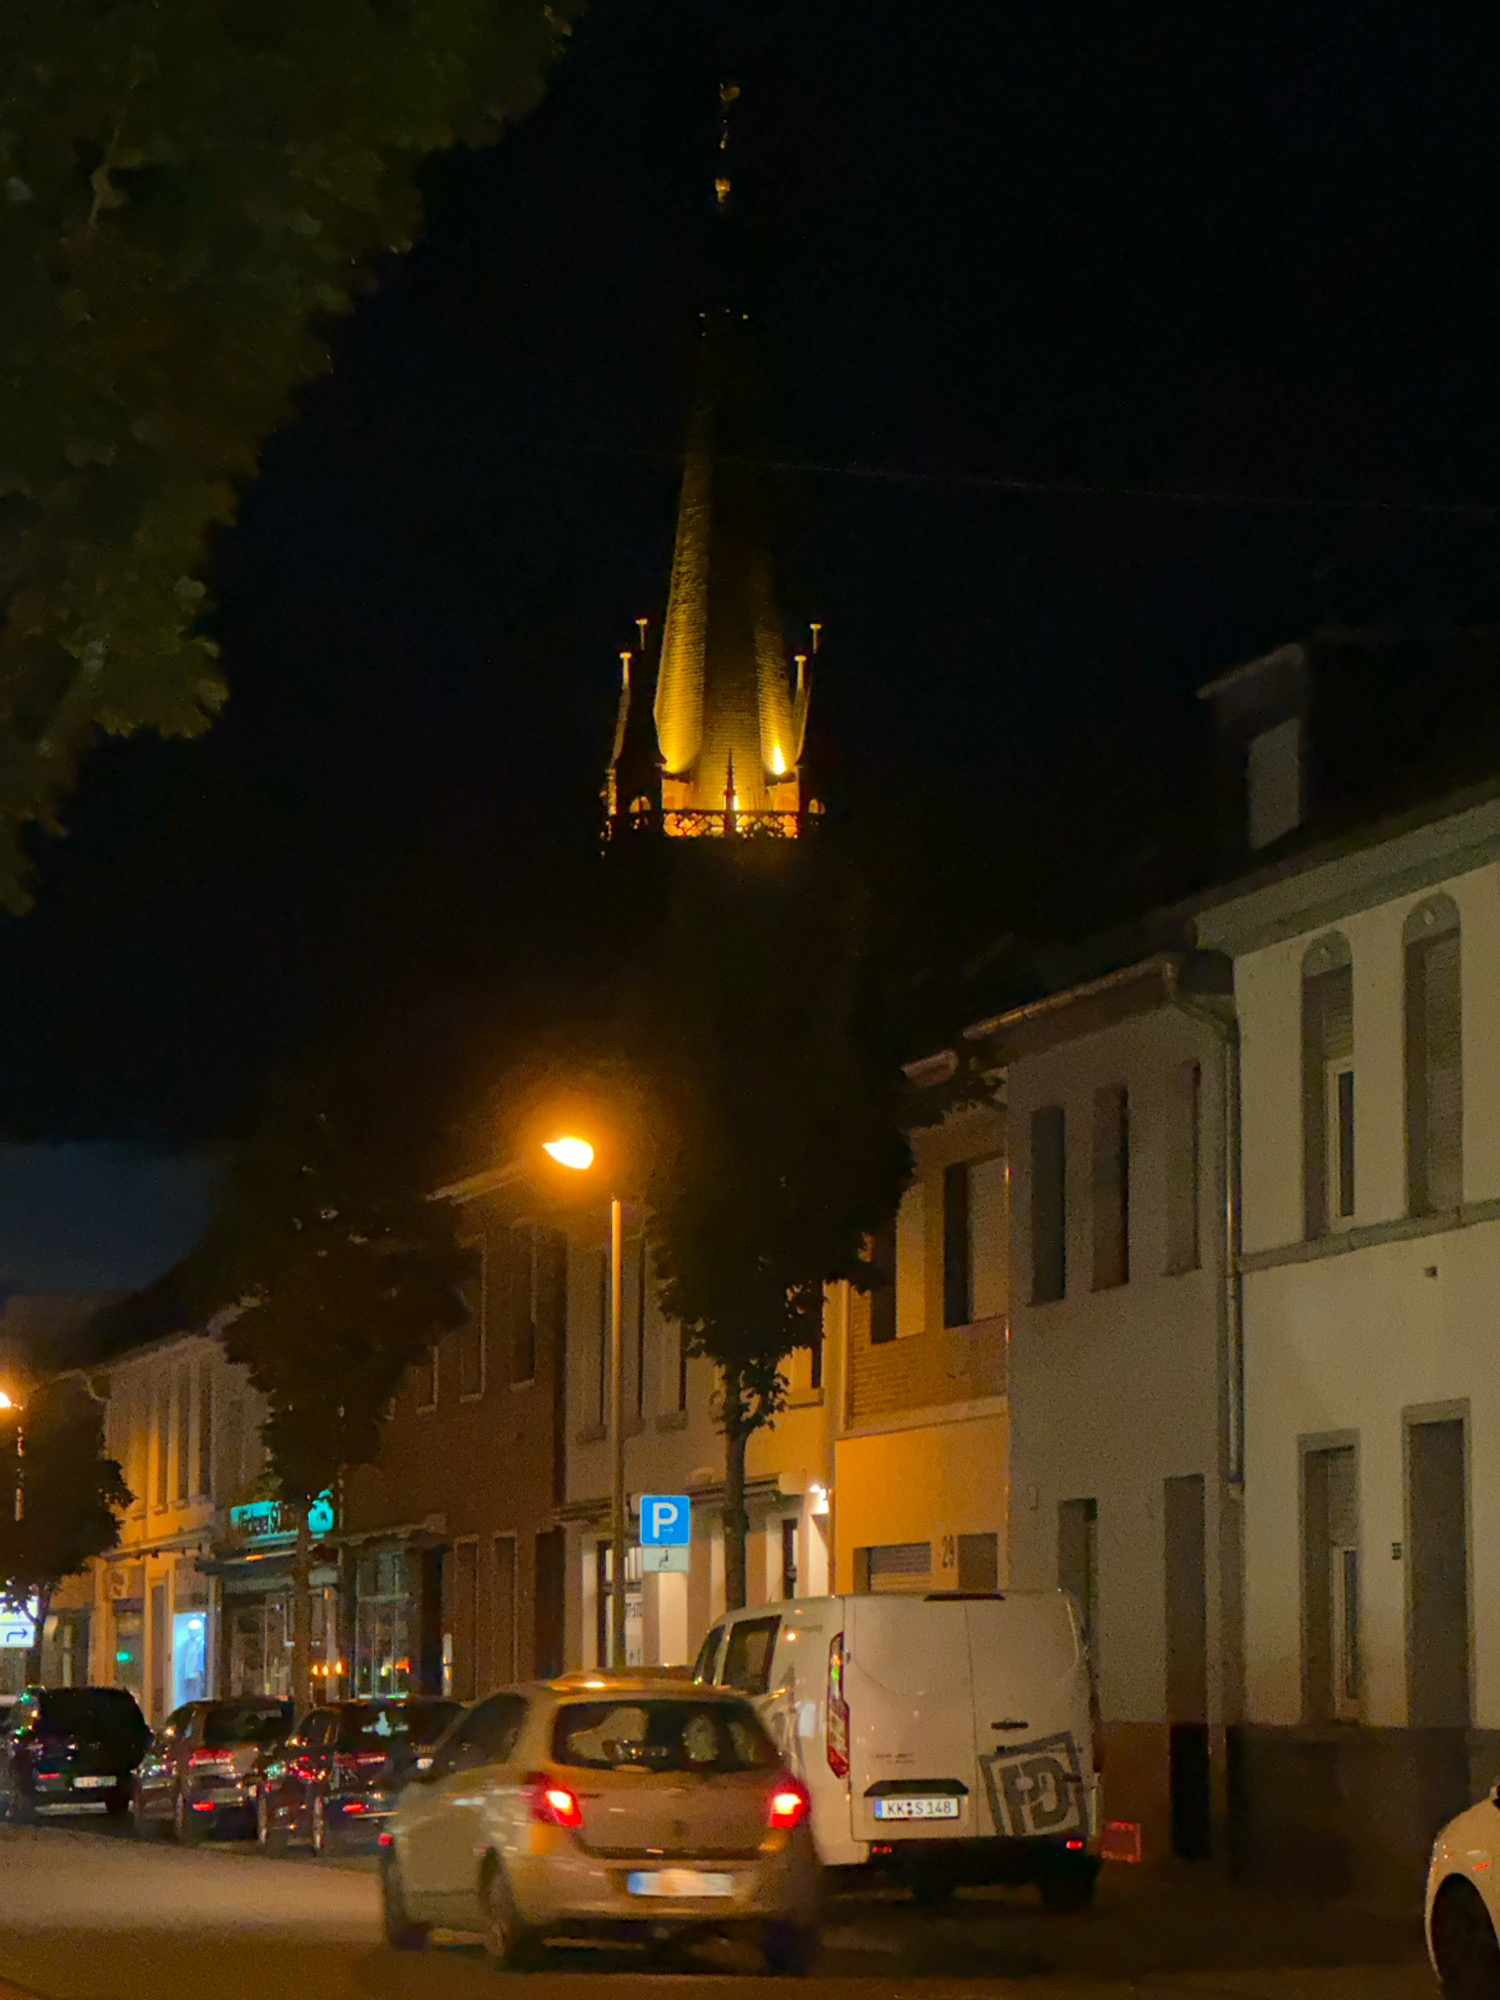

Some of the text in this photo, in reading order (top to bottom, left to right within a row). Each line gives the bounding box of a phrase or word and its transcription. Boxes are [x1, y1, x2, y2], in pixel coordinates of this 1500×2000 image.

[652, 1502, 678, 1539] P
[887, 1803, 905, 1815] KK
[927, 1801, 952, 1814] 148
